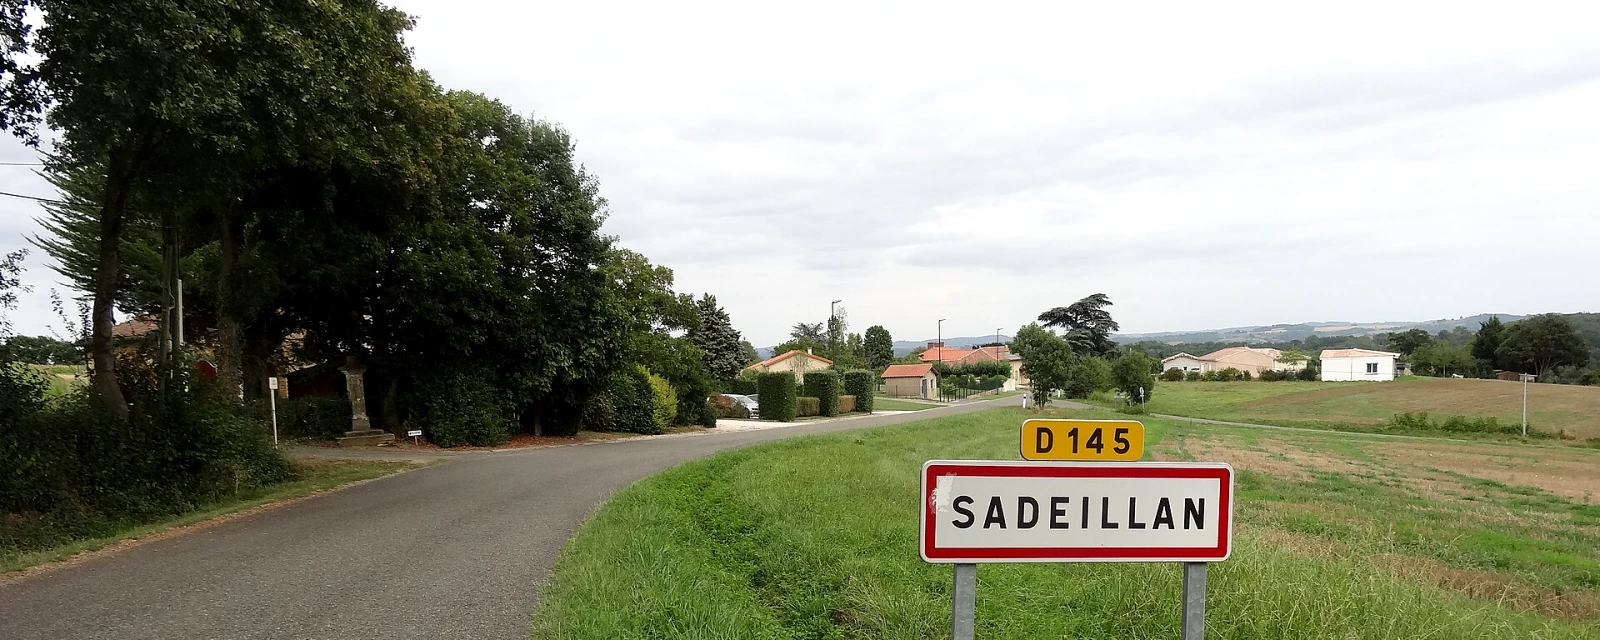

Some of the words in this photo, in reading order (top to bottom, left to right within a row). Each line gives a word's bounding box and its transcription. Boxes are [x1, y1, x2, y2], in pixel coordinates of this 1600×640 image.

[1035, 427, 1054, 454] D
[1067, 427, 1131, 455] 145
[951, 495, 1206, 530] SADEILLAN
